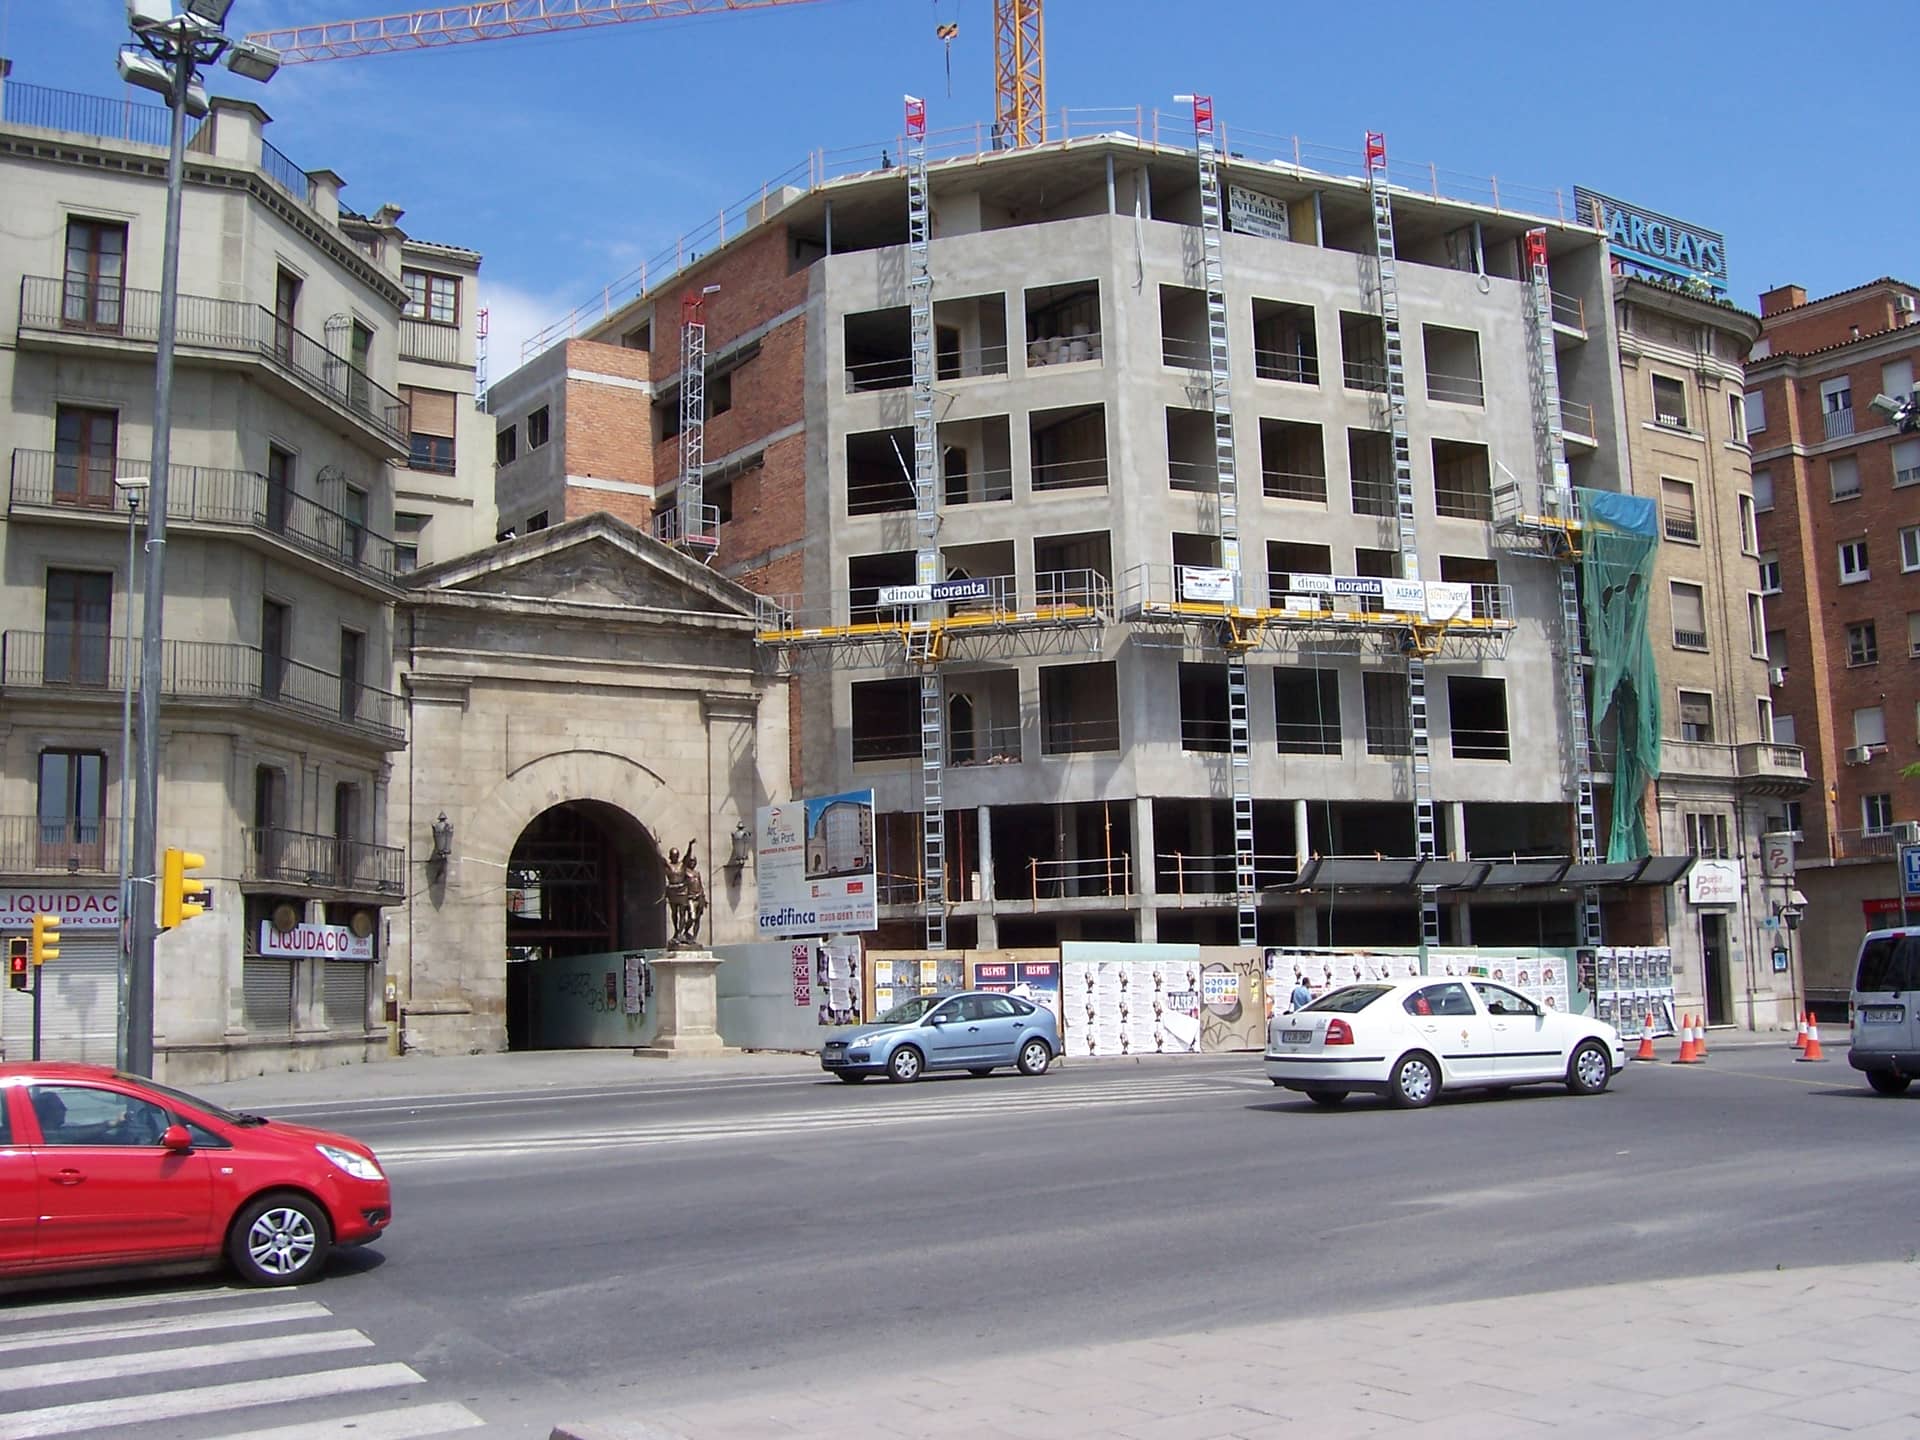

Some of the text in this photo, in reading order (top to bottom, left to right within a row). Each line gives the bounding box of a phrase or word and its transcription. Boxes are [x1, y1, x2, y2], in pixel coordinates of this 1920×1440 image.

[1231, 187, 1284, 211] ESPAIS
[1231, 199, 1285, 222] INTERIORS
[1603, 206, 1721, 273] ARCLAYS
[887, 581, 985, 602] dinou noranta
[1297, 576, 1329, 590] dinou
[1336, 580, 1381, 592] noranta
[1395, 587, 1424, 599] ALFARO
[760, 907, 816, 928] credifinca
[269, 928, 349, 952] LIQUIDACIÓ
